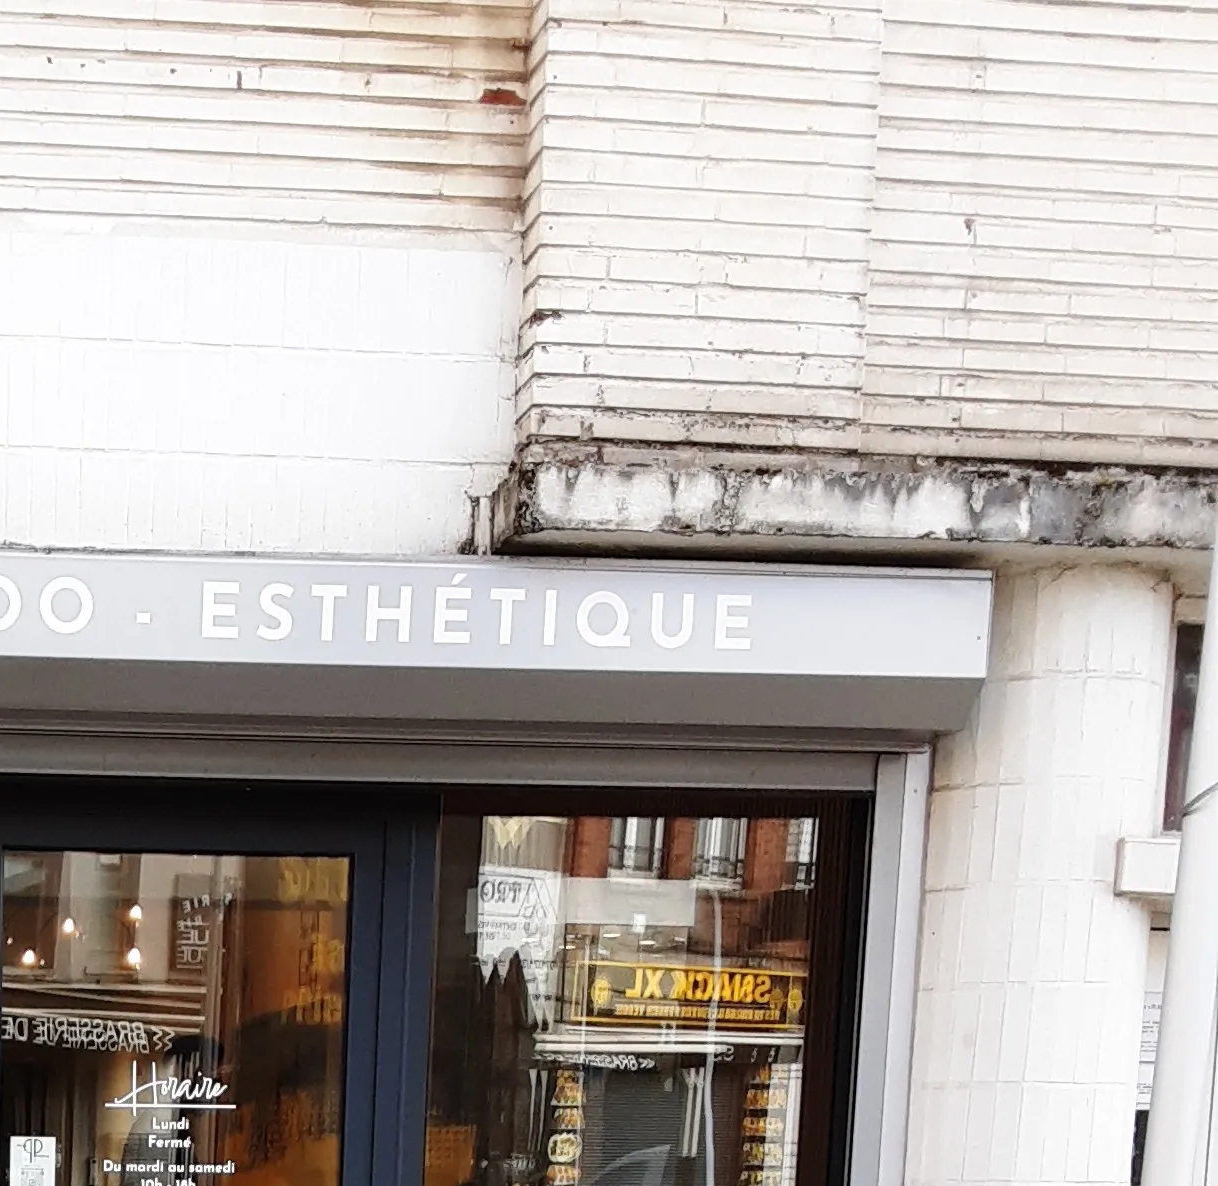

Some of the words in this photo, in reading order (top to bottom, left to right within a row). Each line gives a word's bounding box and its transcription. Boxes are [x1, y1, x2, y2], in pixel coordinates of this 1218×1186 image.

[201, 573, 753, 650] ESTHÉTIQUE
[115, 1060, 228, 1116] Horaire
[152, 1116, 190, 1130] Lundi
[148, 1135, 192, 1148] Fermé
[103, 1159, 121, 1172] Du
[126, 1159, 164, 1173] mardi
[168, 1164, 184, 1173] au
[189, 1160, 235, 1173] samedi
